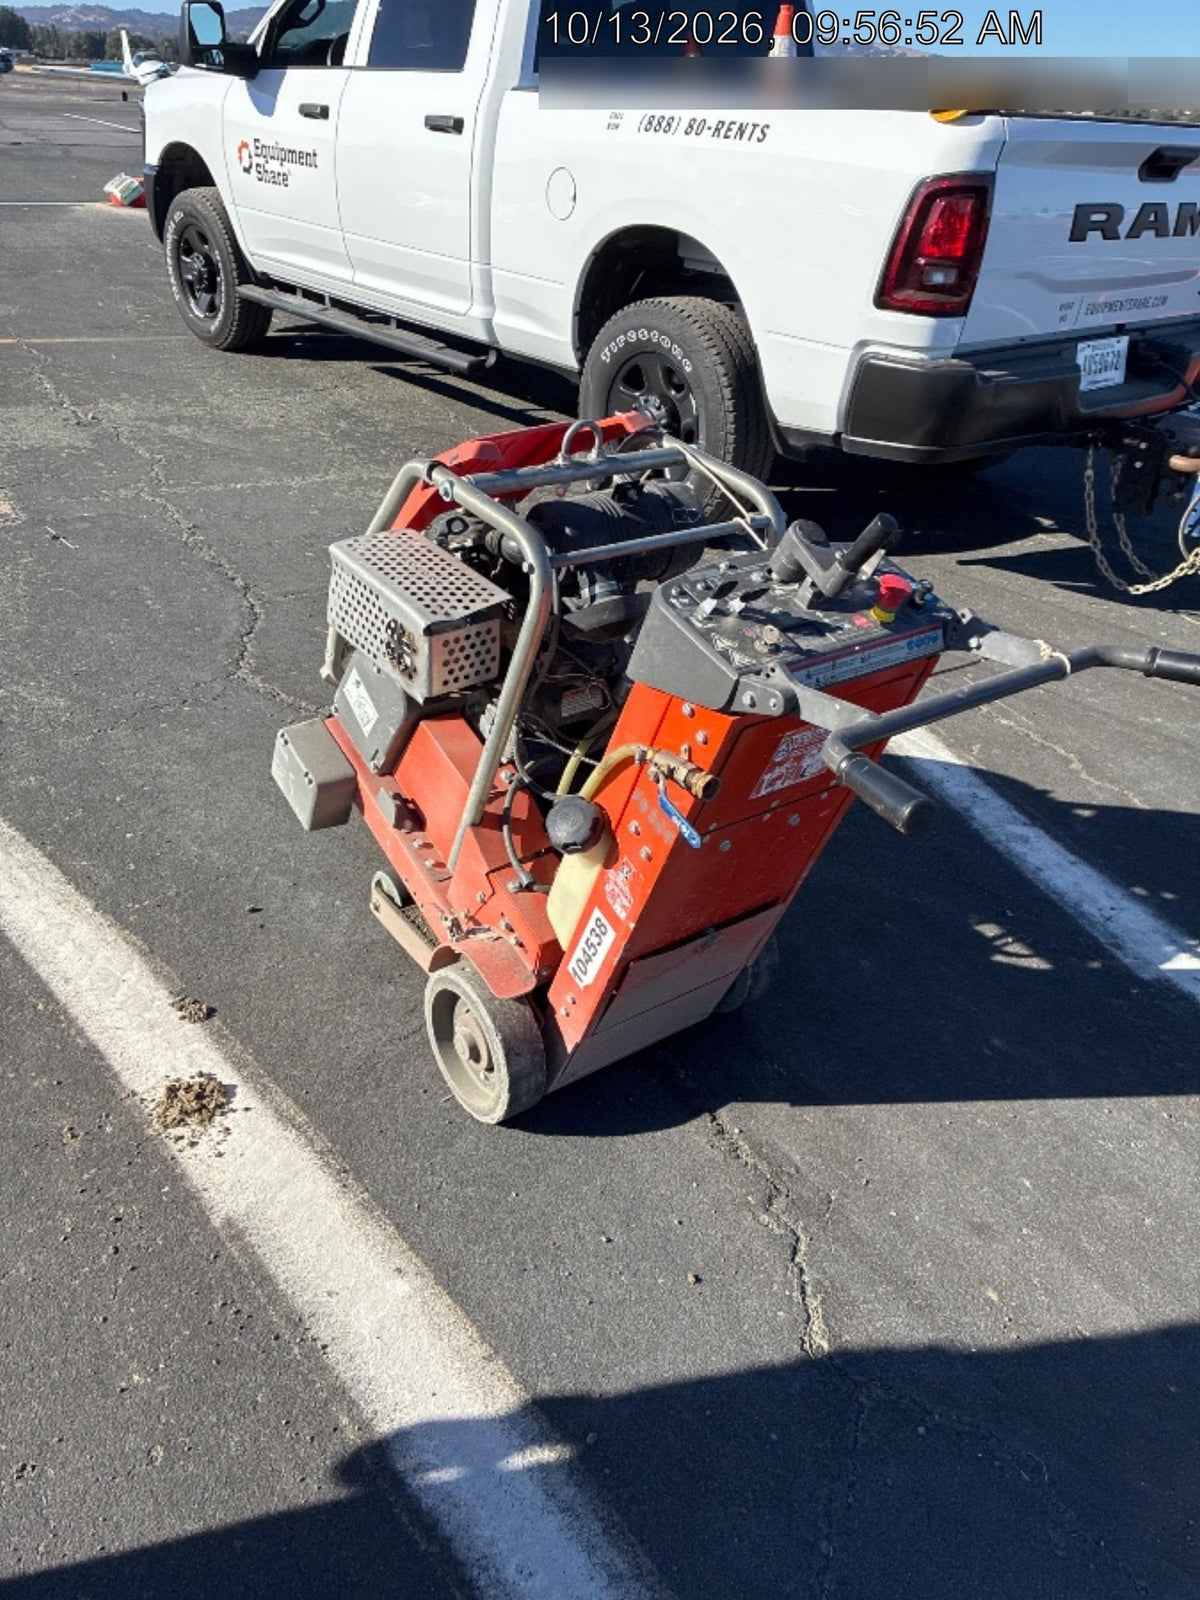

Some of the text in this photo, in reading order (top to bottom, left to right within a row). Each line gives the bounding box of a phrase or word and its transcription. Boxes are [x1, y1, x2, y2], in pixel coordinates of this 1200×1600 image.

[638, 113, 771, 143] (888) 80-RENTS
[253, 138, 319, 169] Equipment
[571, 916, 609, 984] 104538
